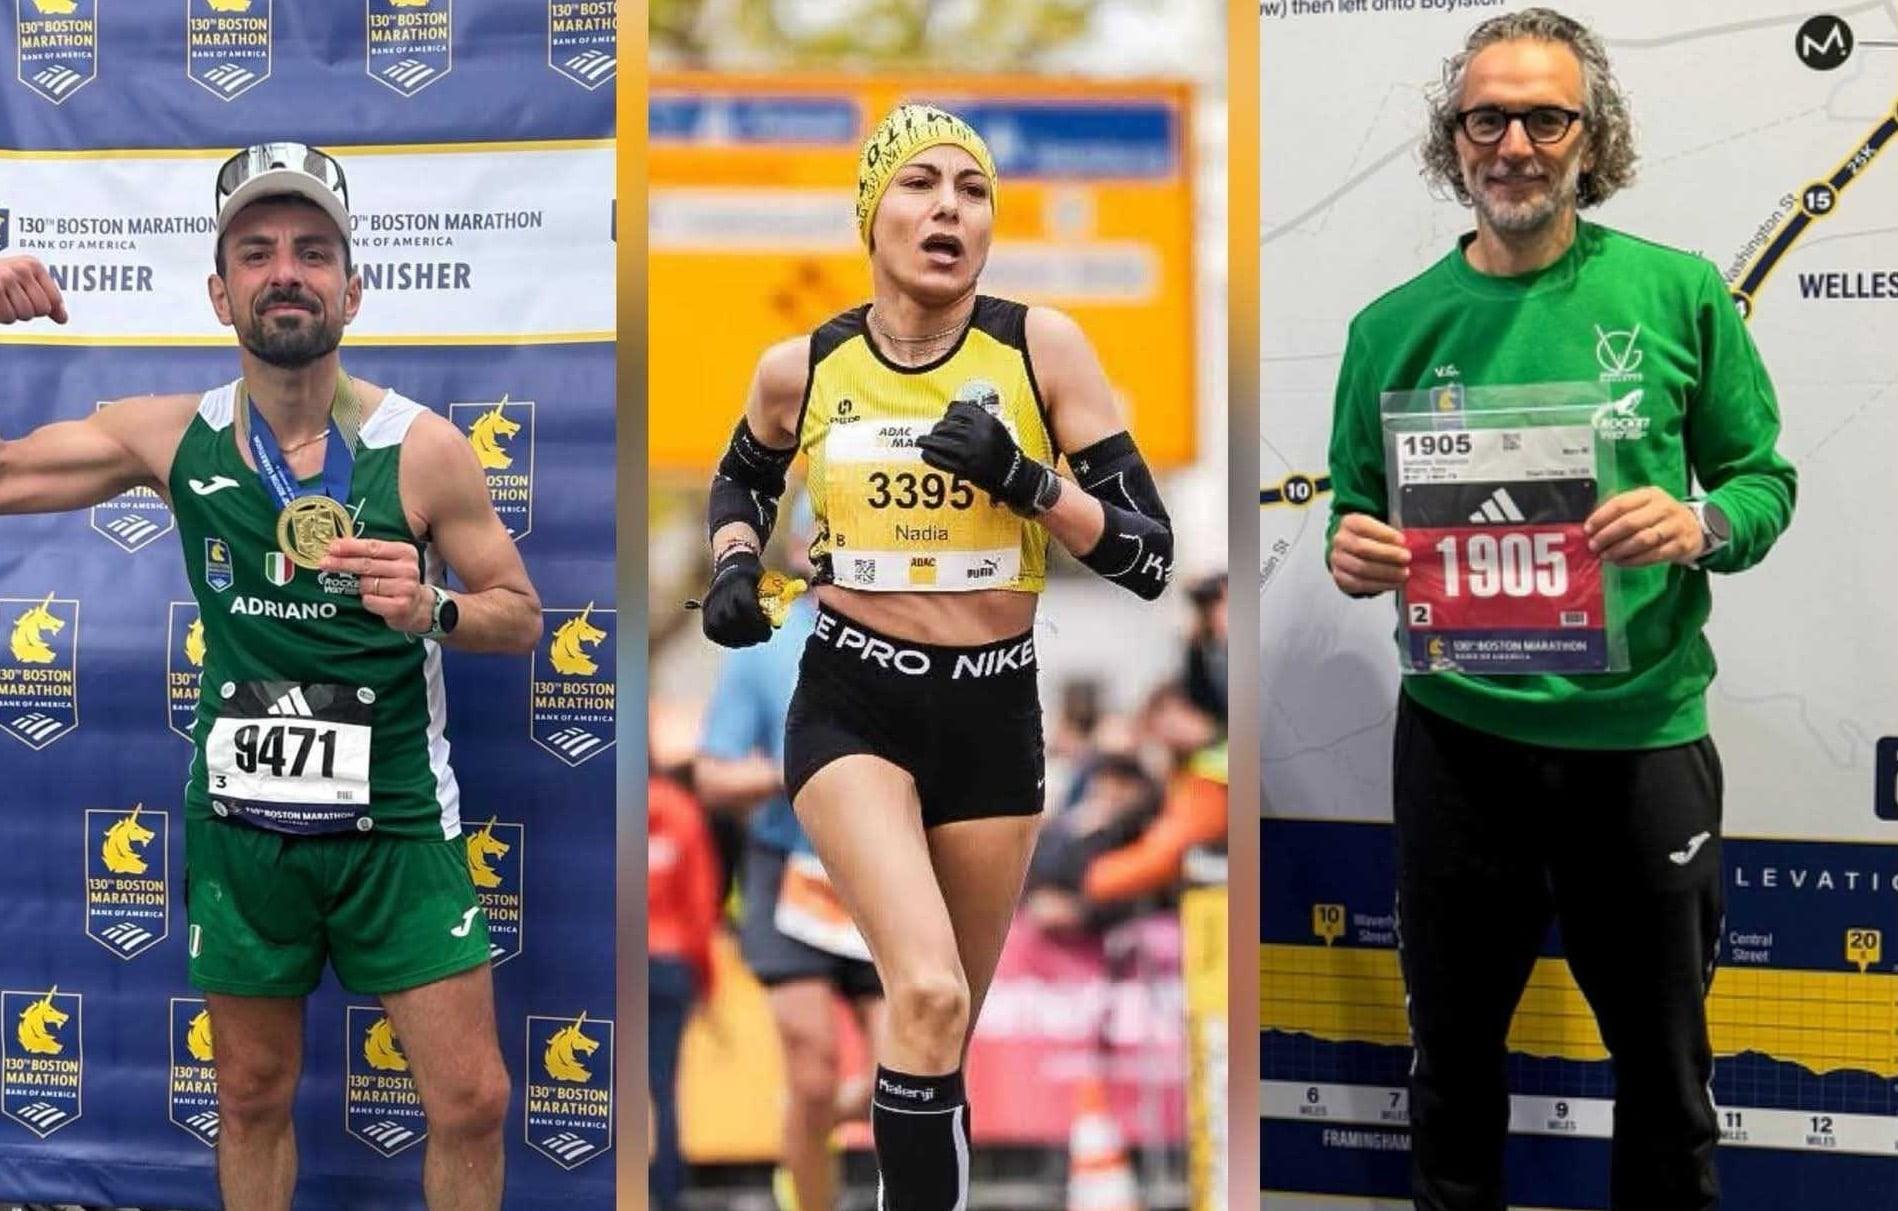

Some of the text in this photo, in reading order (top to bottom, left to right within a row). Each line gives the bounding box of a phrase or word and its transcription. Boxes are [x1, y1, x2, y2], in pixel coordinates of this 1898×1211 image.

[1291, 0, 1334, 14] then
[45, 20, 92, 33] BOSTON
[219, 18, 267, 30] BOSTON
[398, 13, 447, 26] BOSTON
[22, 35, 92, 48] MARATHON
[192, 33, 267, 46] MARATHON
[371, 27, 447, 42] MARATHON
[1805, 192, 1831, 211] 15
[57, 218, 123, 235] BOSTON
[127, 216, 217, 234] MARATHON
[371, 213, 439, 231] BOSTON
[445, 210, 543, 231] MARATHON
[19, 239, 136, 250] BANK OF AMERICA
[374, 238, 390, 246] OF
[393, 236, 453, 246] AMERICA
[1403, 432, 1472, 456] 1905
[486, 475, 528, 488] OSTON
[491, 488, 528, 501] THON
[867, 471, 974, 510] 3395
[1287, 482, 1310, 500] 10
[836, 534, 846, 547] B
[895, 525, 949, 541] Nadia
[1435, 533, 1569, 598] 1905
[230, 596, 337, 619] ADRIANO
[1413, 605, 1429, 624] 2
[1479, 640, 1522, 651] BOSTON
[1523, 640, 1588, 651] MARATHON
[836, 627, 931, 675] PRO
[952, 638, 1034, 680] NIKE
[23, 668, 71, 682] BOSTON
[0, 683, 73, 696] MARATHON
[563, 682, 614, 695] BOSTON
[535, 697, 614, 710] MARATHON
[234, 725, 336, 779] 9471
[215, 775, 227, 789] 3
[116, 879, 164, 892] BOSTON
[91, 892, 164, 905] MARATHON
[1319, 907, 1340, 924] 10
[1729, 931, 1773, 948] Central
[1850, 931, 1877, 950] 20
[1732, 948, 1769, 962] Street
[31, 1059, 78, 1073] BOSTON
[6, 1073, 78, 1087] MARATHON
[351, 1089, 420, 1105] MARATHO
[558, 1087, 608, 1102] BOSTON
[1306, 1086, 1320, 1104] 6
[1389, 1092, 1400, 1109] 7
[530, 1101, 608, 1117] MARATHON
[1554, 1102, 1568, 1118] 9
[1725, 1112, 1742, 1128] 11
[1810, 1116, 1834, 1134] 12
[1322, 1128, 1412, 1149] FRAMINGHAM
